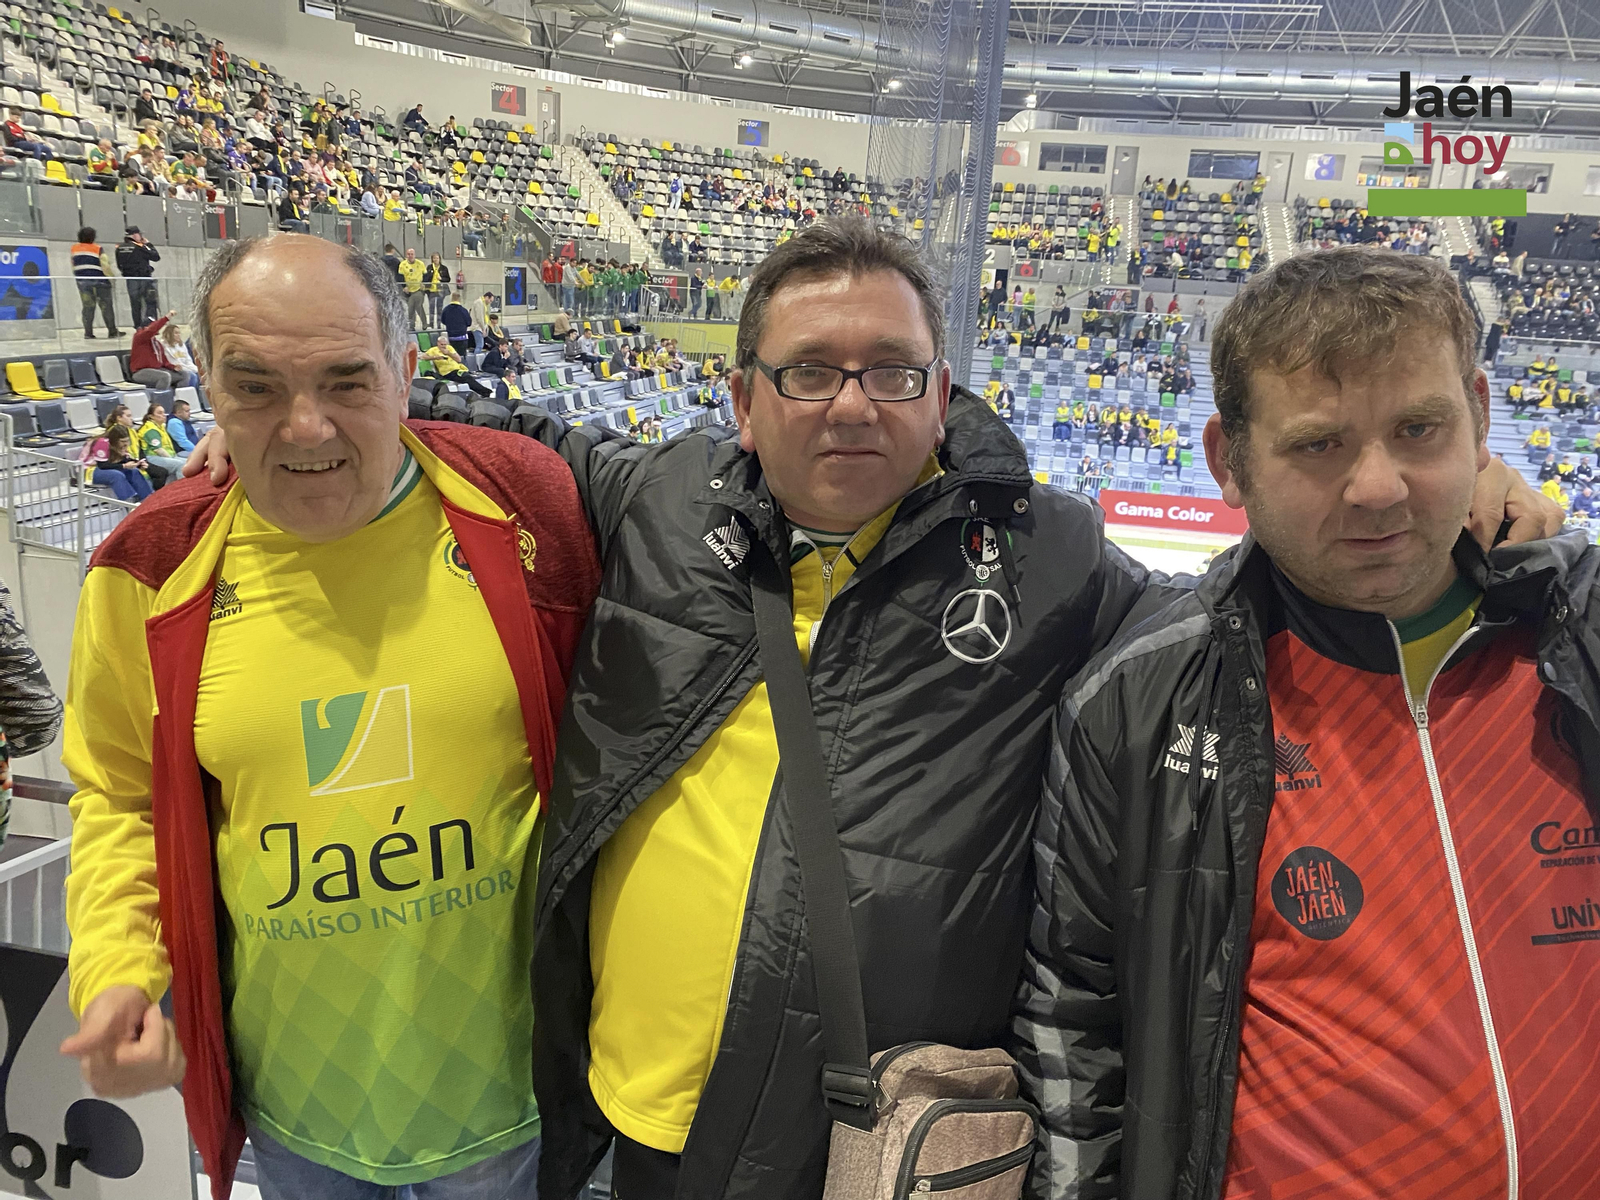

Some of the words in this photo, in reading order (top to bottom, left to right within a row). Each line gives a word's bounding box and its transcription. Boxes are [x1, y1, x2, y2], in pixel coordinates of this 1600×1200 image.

[491, 82, 514, 93] Sector
[499, 85, 519, 115] 4
[737, 118, 758, 128] Sector
[745, 120, 762, 146] 5
[995, 140, 1017, 148] Sector
[1002, 141, 1021, 166] 6
[1315, 153, 1335, 180] 8
[561, 238, 577, 260] 4
[983, 248, 996, 265] 2
[651, 275, 674, 285] ector
[1020, 259, 1034, 277] 6
[510, 267, 523, 305] 3
[1181, 322, 1191, 335] 7
[1114, 501, 1164, 519] Gama
[1167, 506, 1215, 523] Color
[702, 531, 740, 571] luanvi
[1163, 753, 1220, 781] luavi
[260, 804, 475, 910] Jaén
[1284, 859, 1340, 897] JAÉN,
[244, 908, 362, 941] PARAÍSO
[370, 868, 517, 930] INTERIOR
